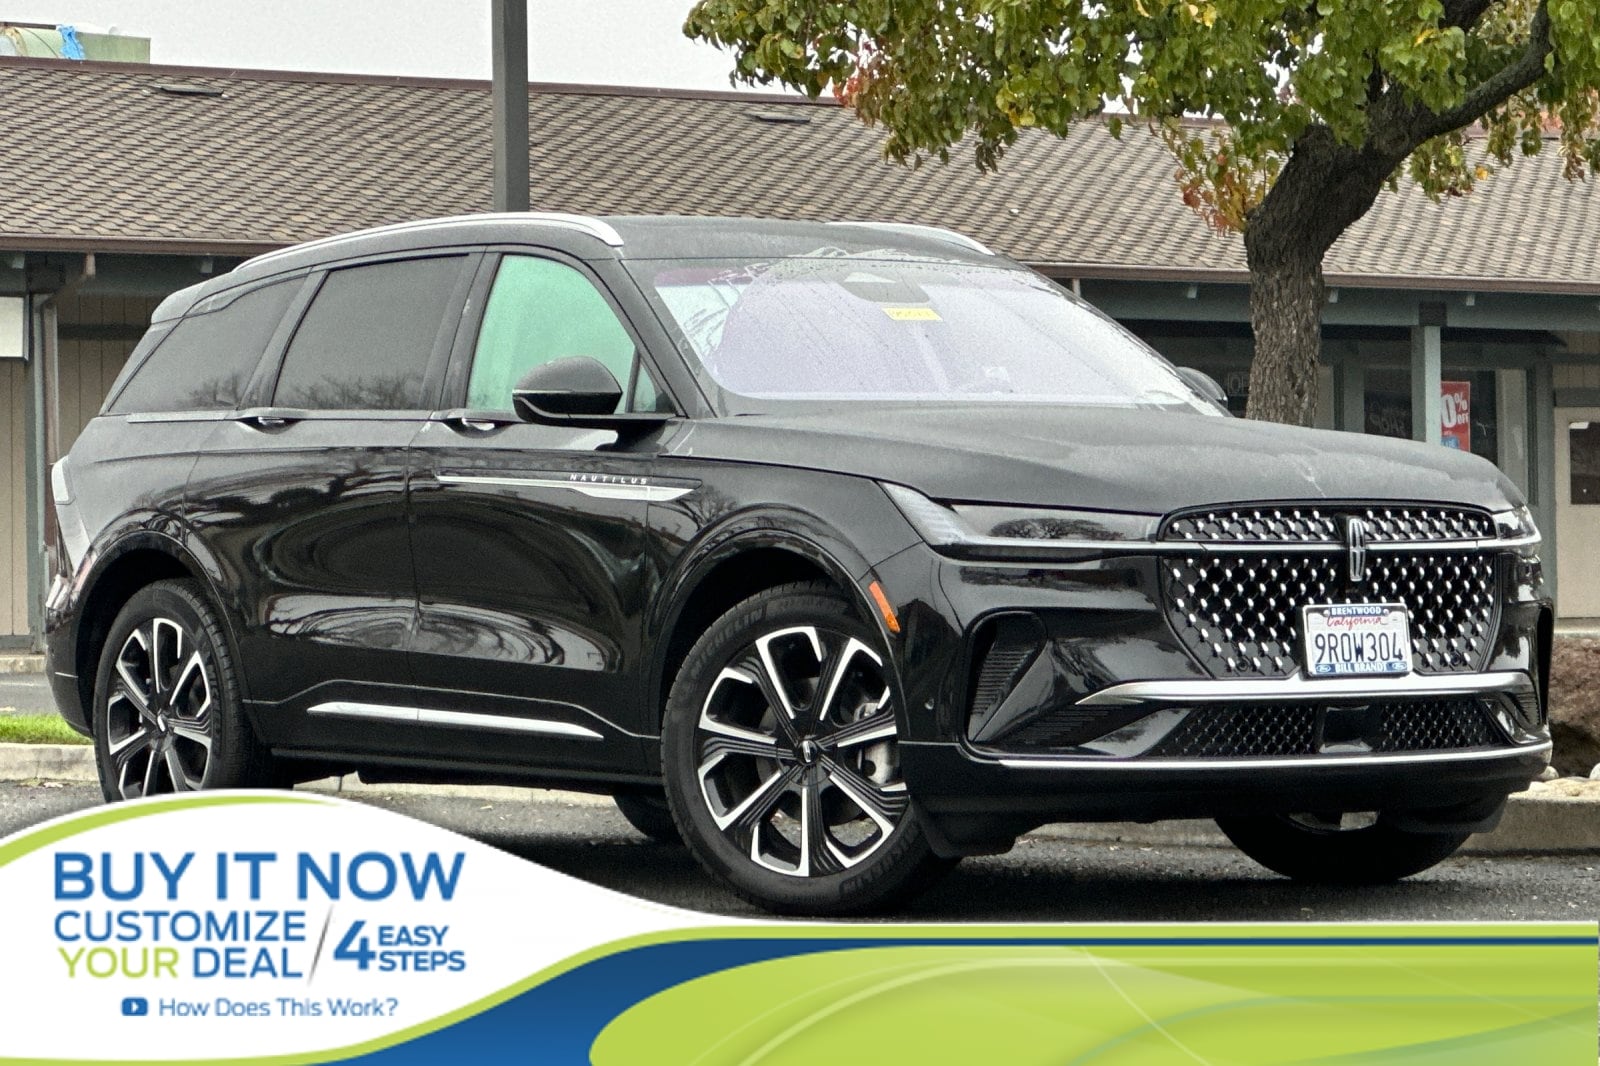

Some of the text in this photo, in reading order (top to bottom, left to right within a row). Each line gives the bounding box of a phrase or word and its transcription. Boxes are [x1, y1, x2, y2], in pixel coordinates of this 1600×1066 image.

[1457, 412, 1469, 424] OFF
[569, 474, 647, 484] NAUTILUS
[1331, 607, 1381, 615] BRENTWOOD
[1326, 616, 1382, 630] California
[1315, 633, 1403, 663] 9ROW304
